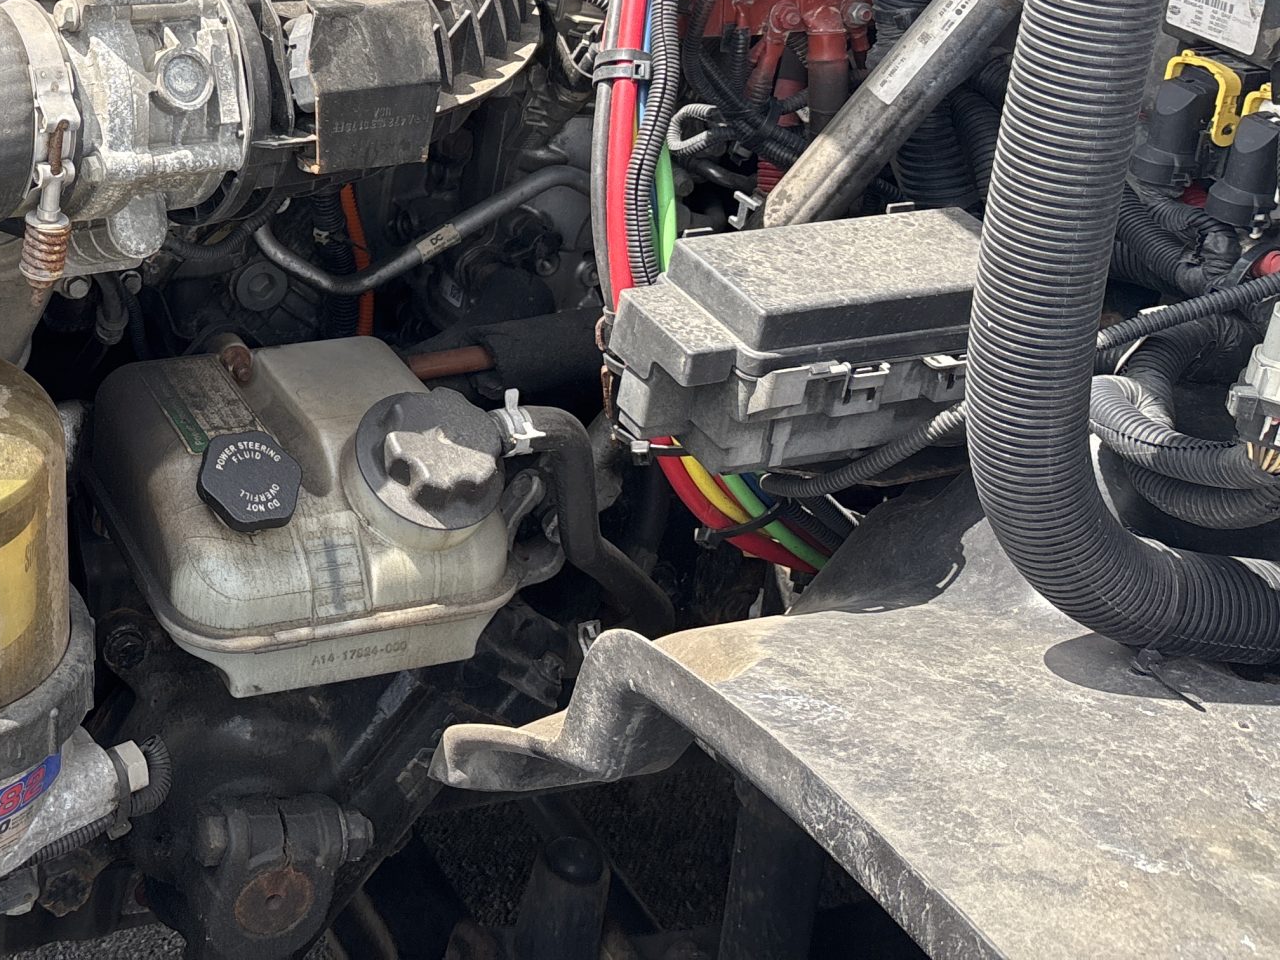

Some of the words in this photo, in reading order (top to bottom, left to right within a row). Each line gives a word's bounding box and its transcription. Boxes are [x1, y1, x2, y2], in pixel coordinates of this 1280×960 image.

[216, 444, 237, 470] POWER
[237, 442, 281, 462] STEERING
[231, 451, 261, 463] FLUID
[239, 483, 280, 502] OVERFILL
[246, 503, 265, 512] NOT
[267, 498, 280, 510] DO
